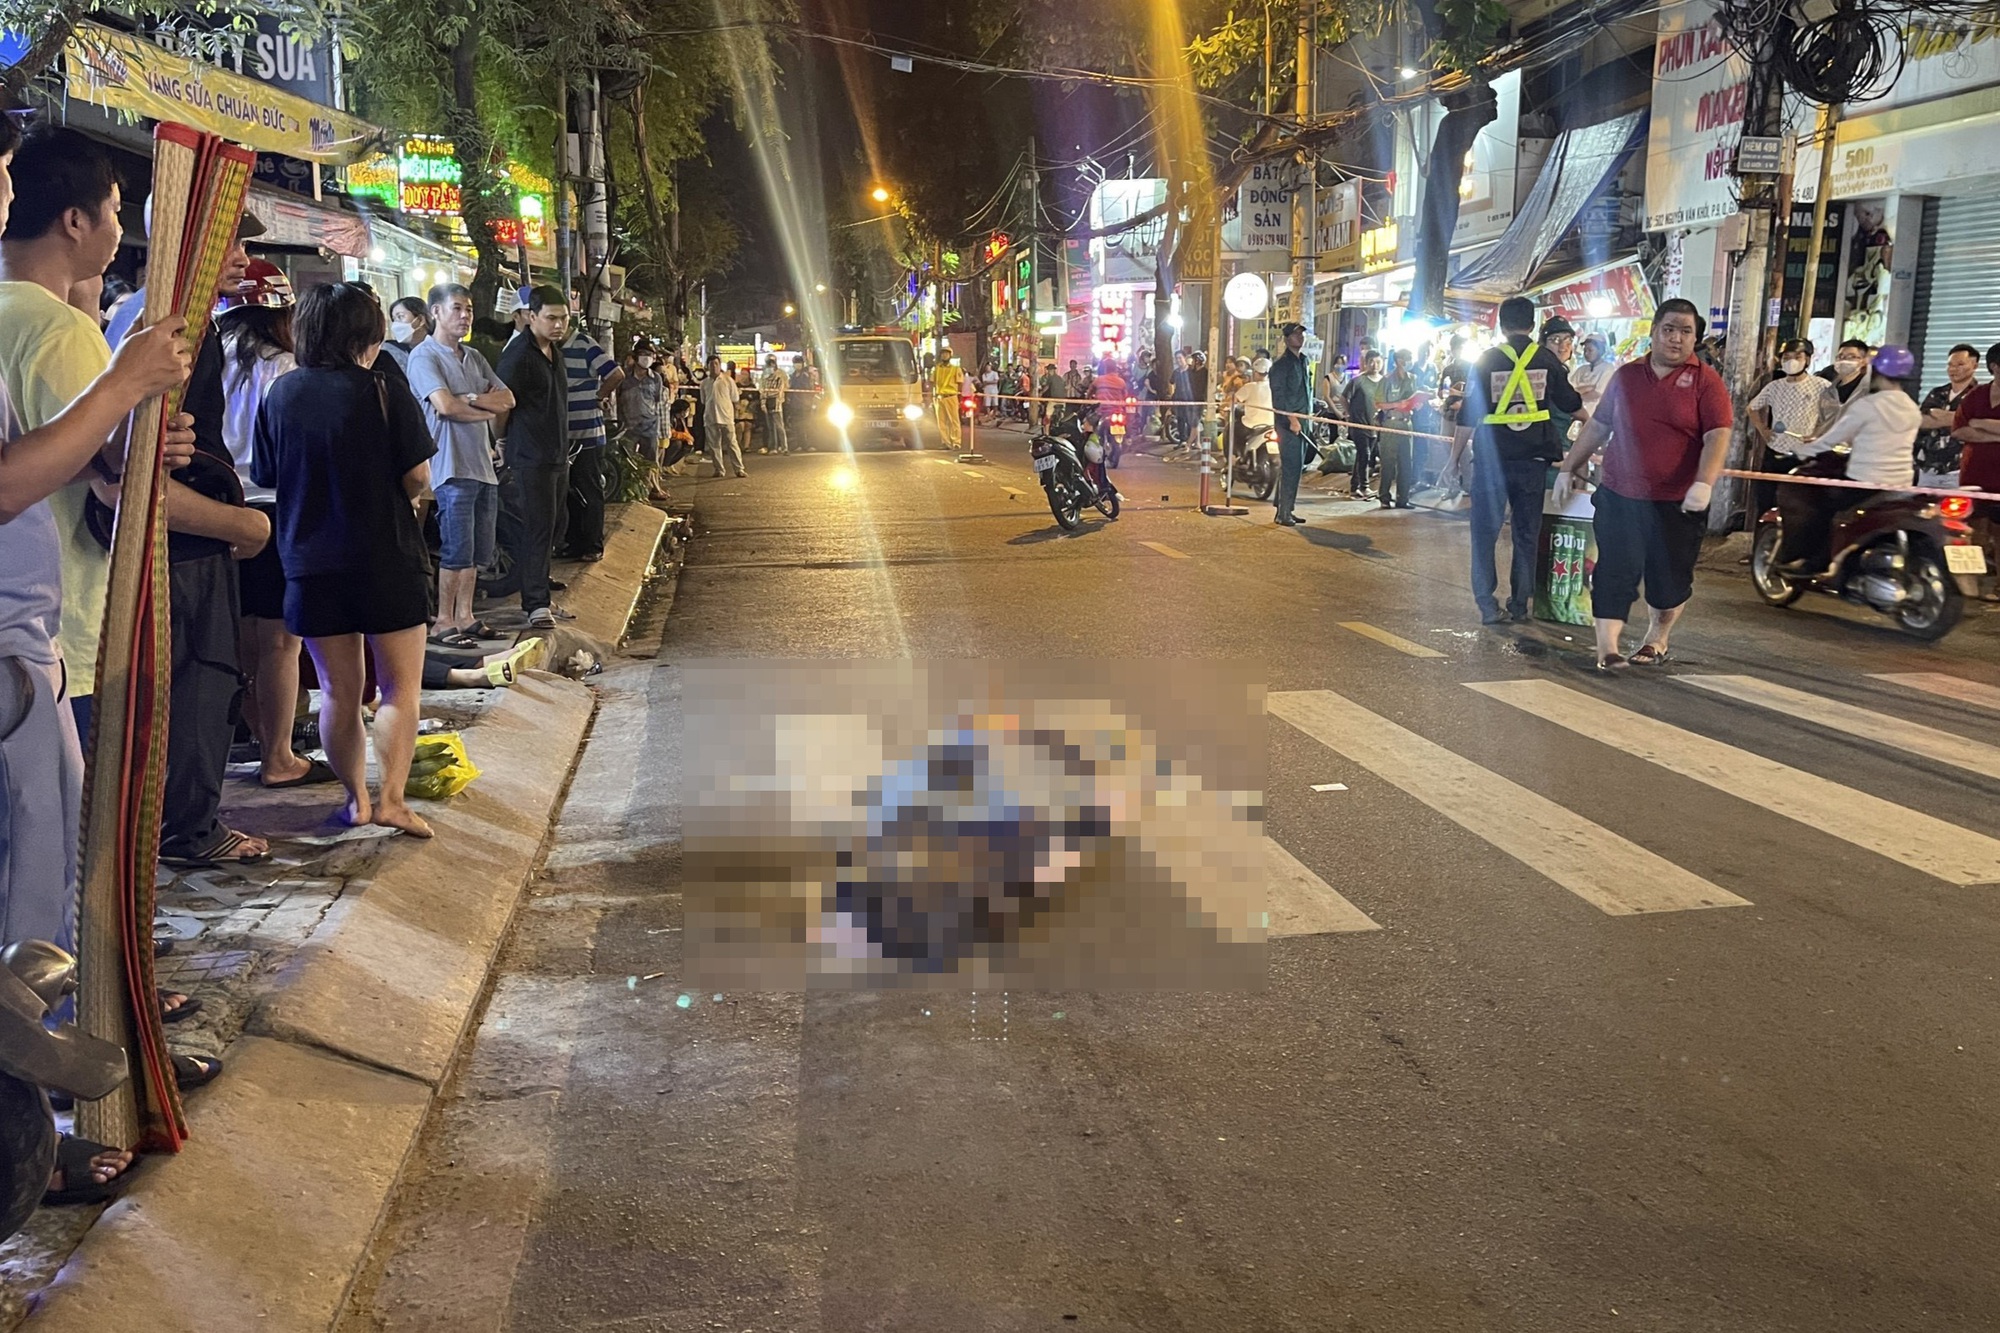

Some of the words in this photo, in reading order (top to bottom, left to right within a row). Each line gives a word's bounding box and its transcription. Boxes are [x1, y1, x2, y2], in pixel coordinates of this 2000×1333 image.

[1658, 31, 1695, 75] PHUN
[262, 105, 286, 132] ĐỨC
[1845, 146, 1875, 168] 500
[1250, 186, 1288, 206] ĐỘNG
[1254, 208, 1281, 227] SẢN
[1791, 212, 1839, 228] NAS
[1183, 263, 1212, 277] NAM
